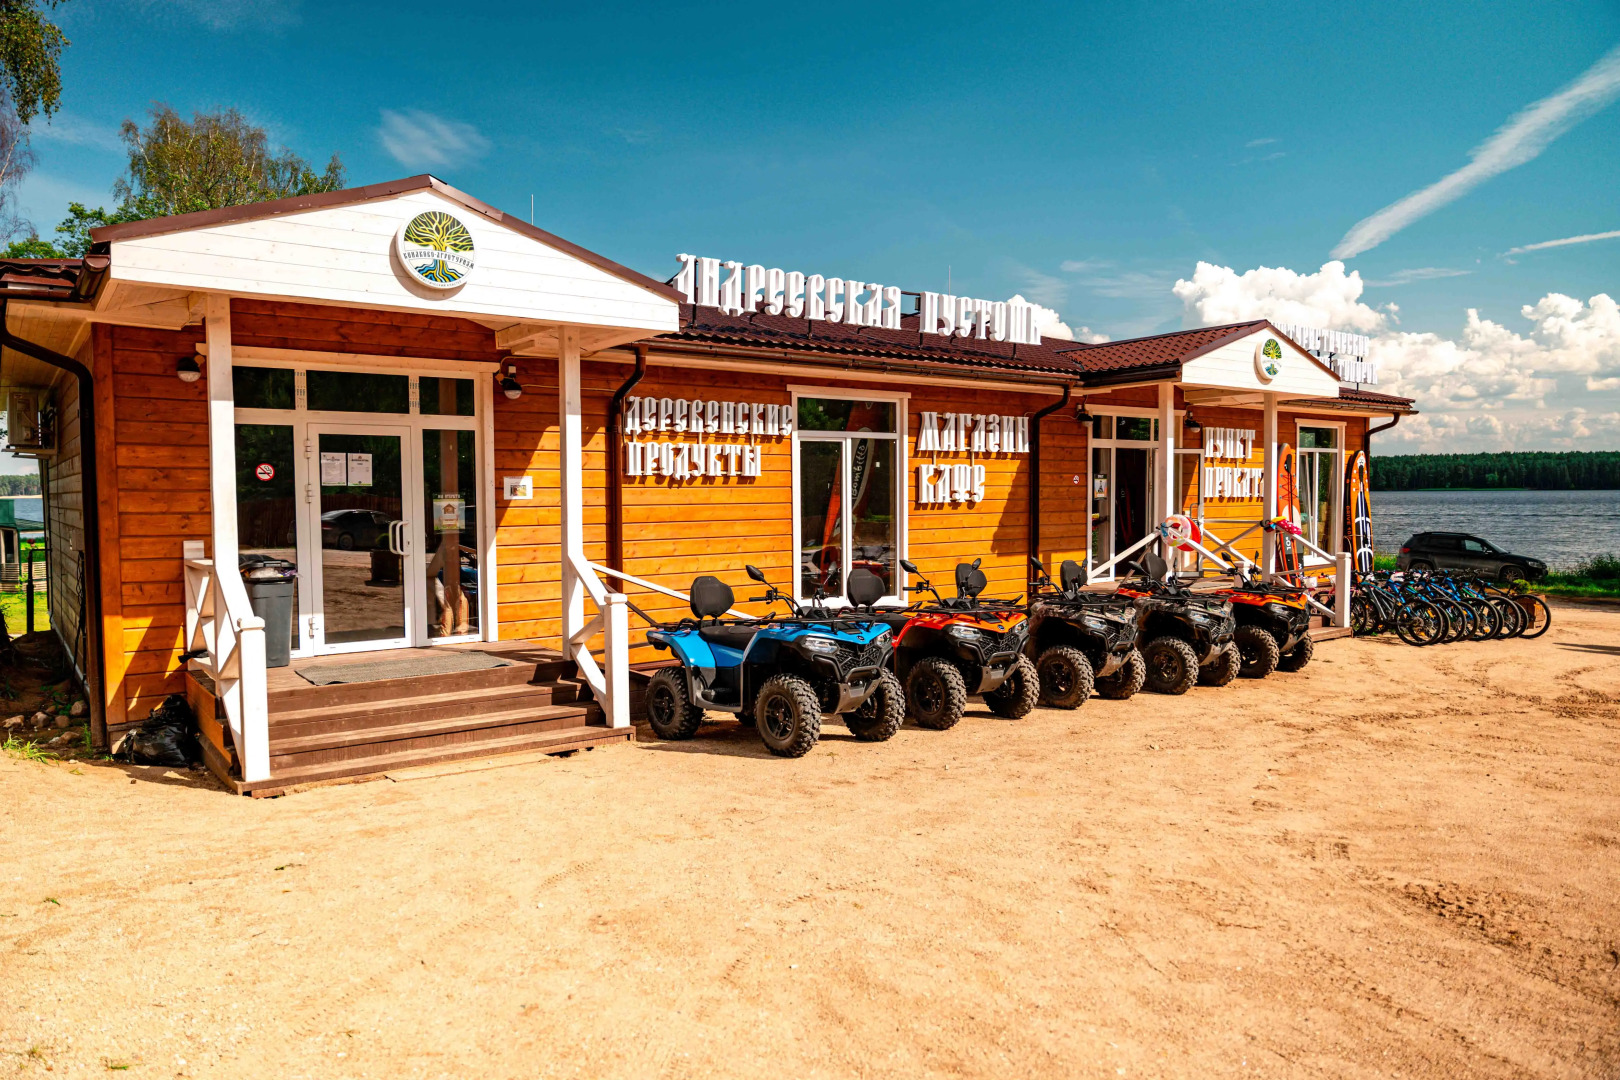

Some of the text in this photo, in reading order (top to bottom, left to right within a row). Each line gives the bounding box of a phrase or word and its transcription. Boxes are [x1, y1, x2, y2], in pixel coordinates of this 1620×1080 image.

[672, 253, 902, 330] АНДРЕЕВСКАЯ
[625, 396, 793, 436] ДЕРЕВЕНСКИЕ
[917, 411, 1030, 453] МАГАЗИН
[626, 442, 762, 480] ПРОДУКТЫ
[1204, 427, 1256, 459] ПУНКТ
[918, 464, 986, 503] КАФЕ
